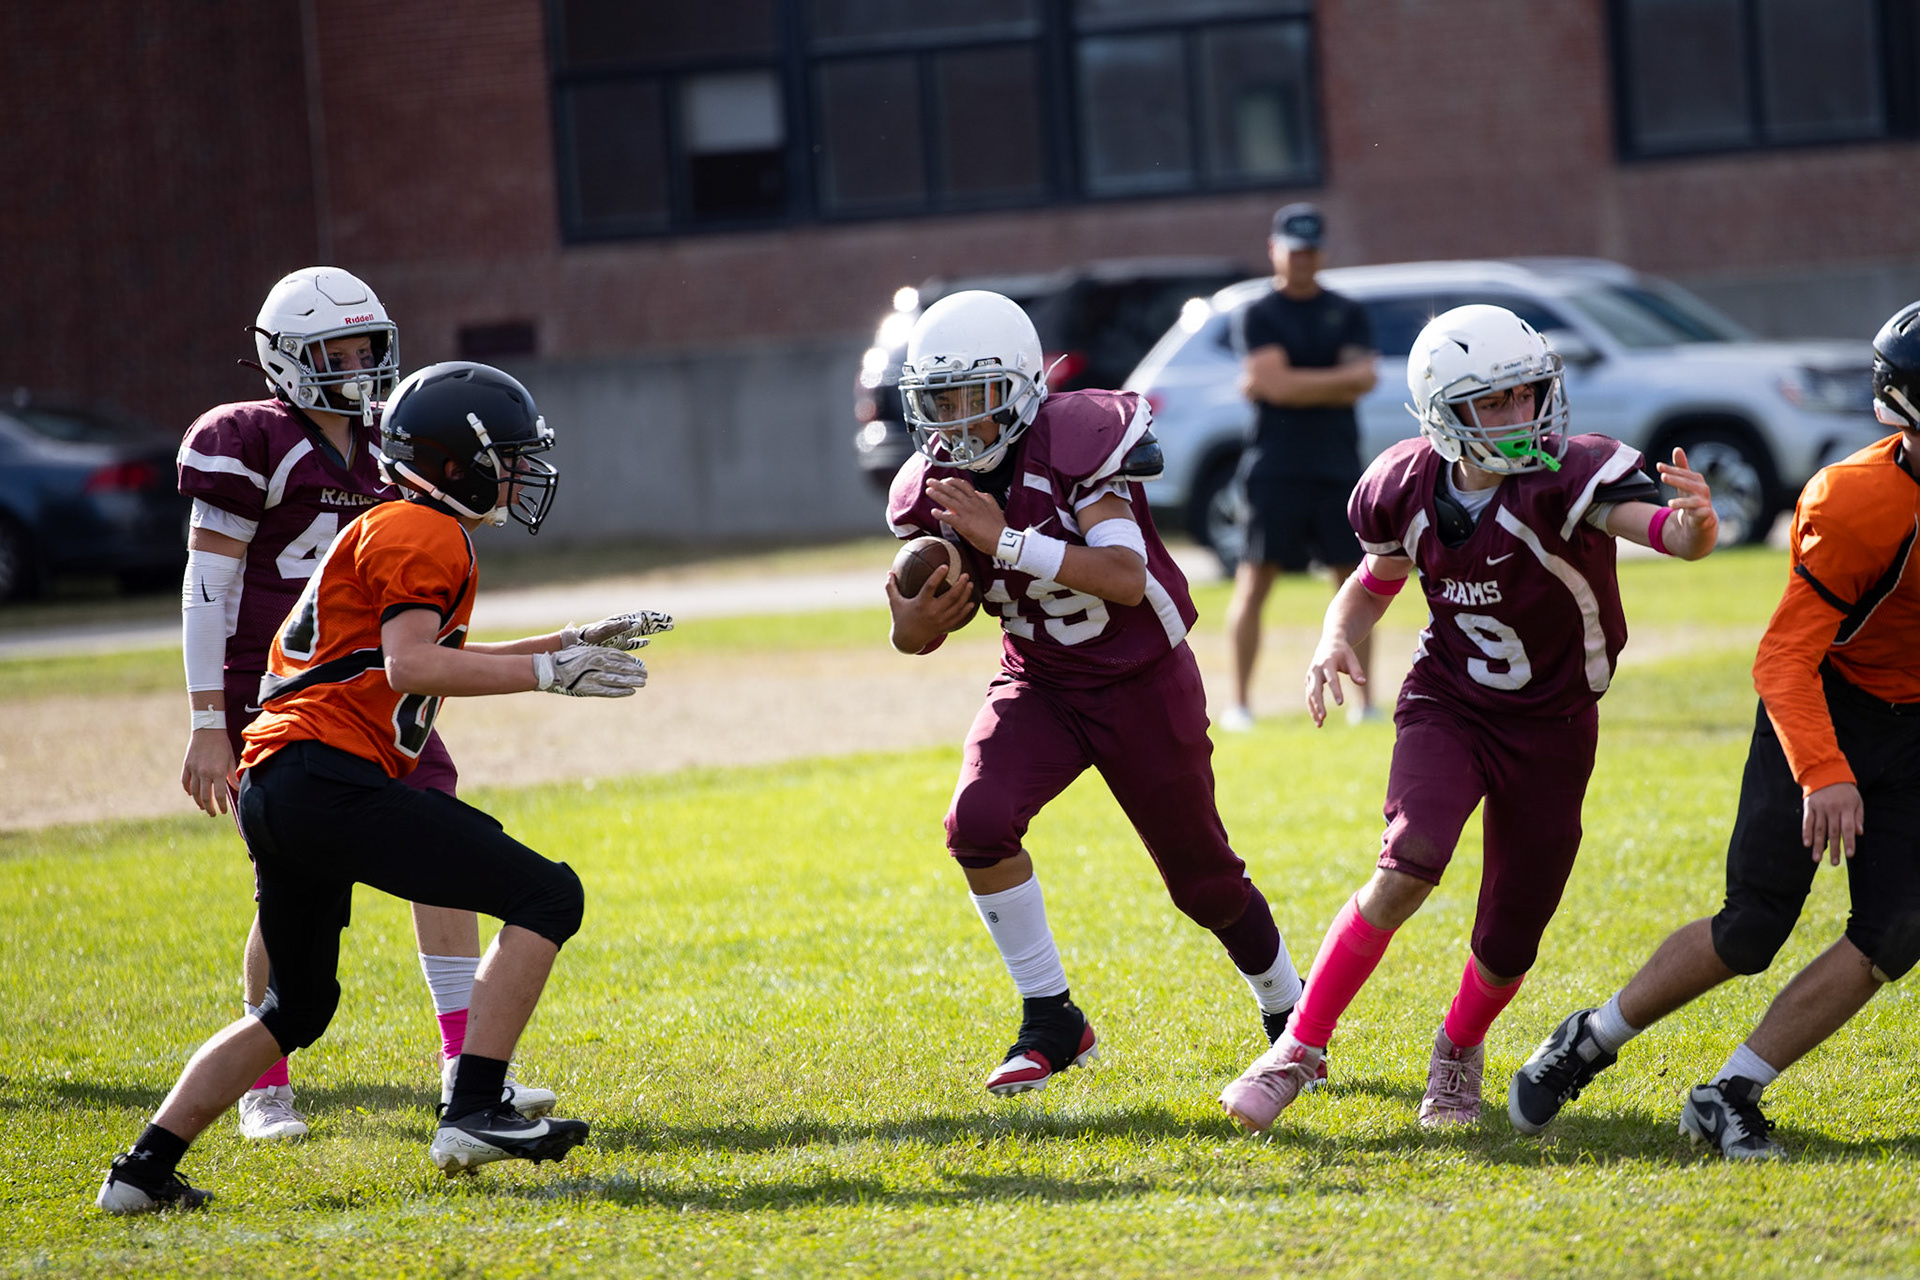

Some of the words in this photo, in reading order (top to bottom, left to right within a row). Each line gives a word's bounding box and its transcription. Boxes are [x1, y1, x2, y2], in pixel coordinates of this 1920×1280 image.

[344, 313, 375, 324] Riddell
[275, 512, 339, 579] 4
[1440, 577, 1503, 606] RAMS
[1453, 612, 1533, 691] 9
